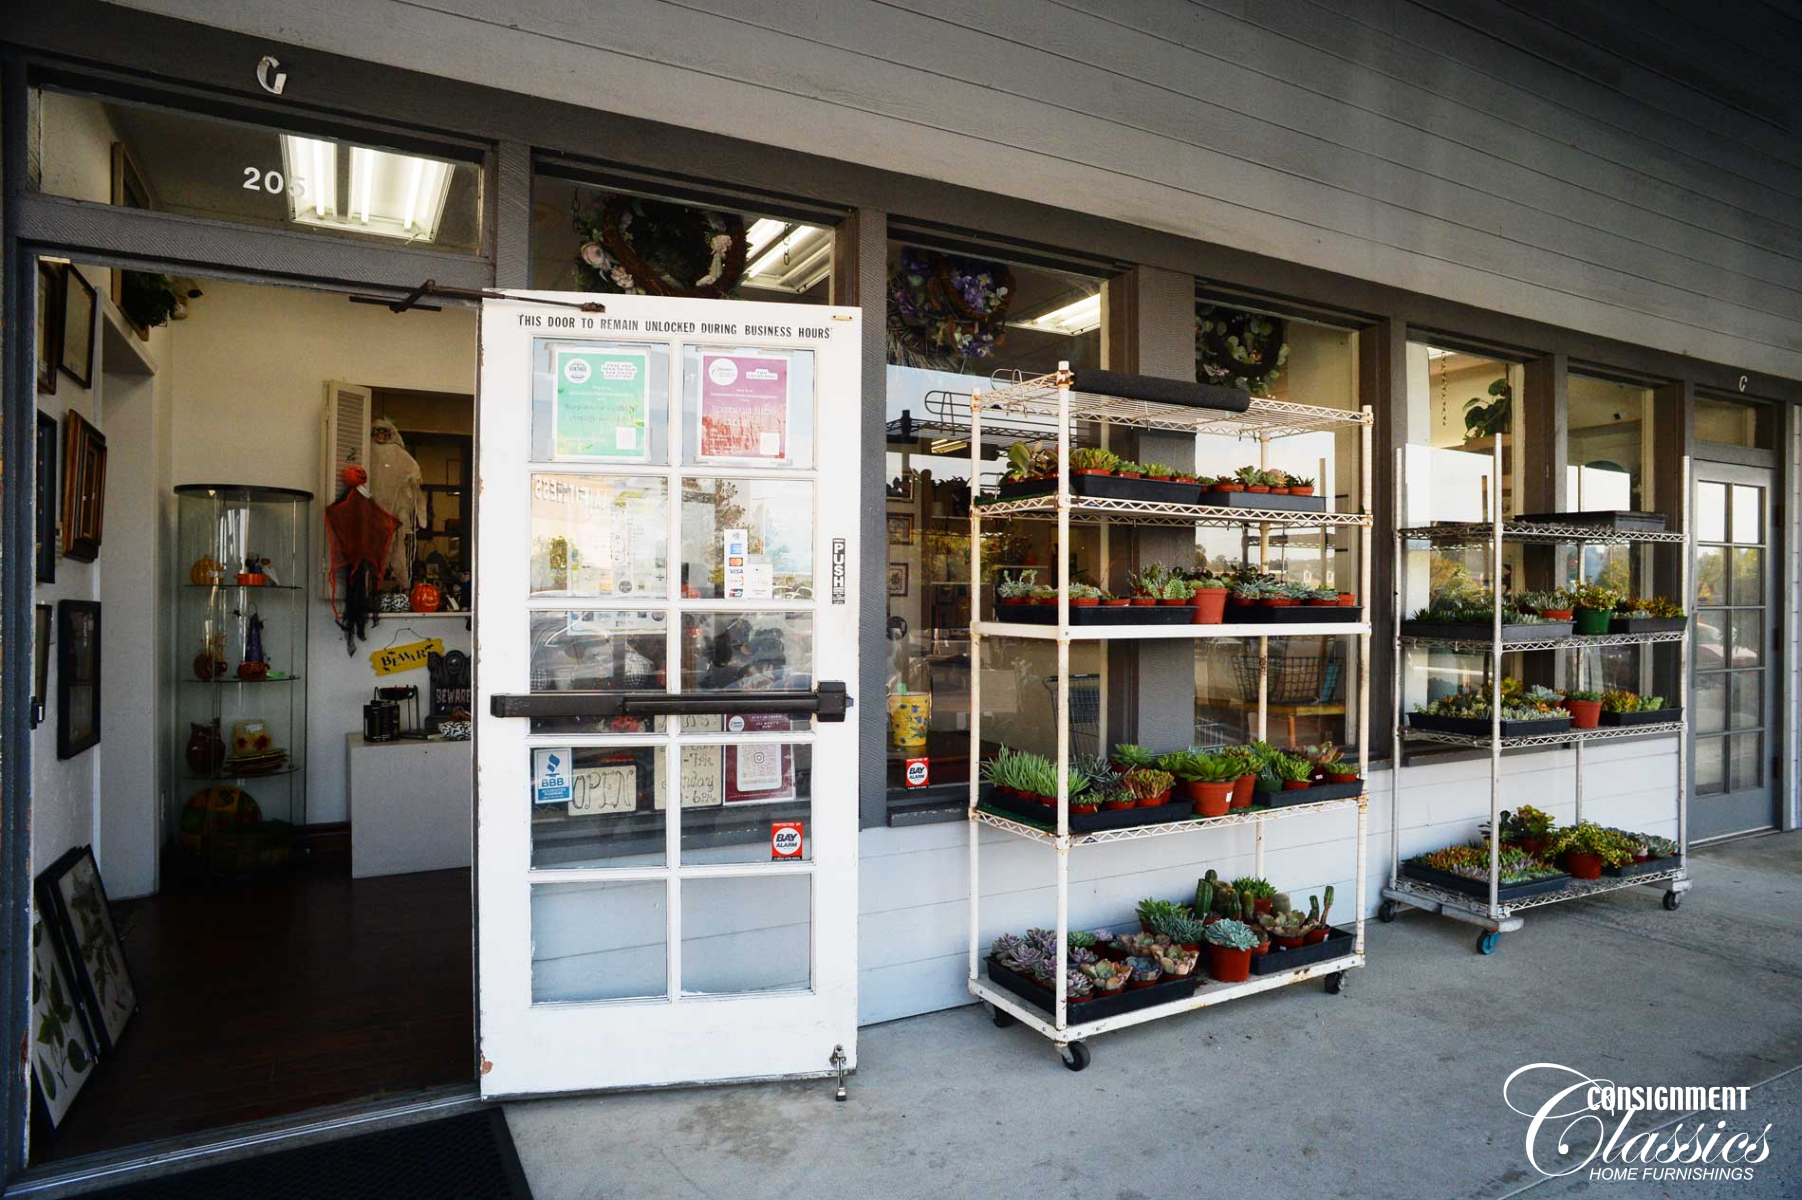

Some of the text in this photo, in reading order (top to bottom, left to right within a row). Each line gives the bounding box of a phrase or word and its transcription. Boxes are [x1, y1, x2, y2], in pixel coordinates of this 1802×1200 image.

[518, 314, 830, 339] THIS DOOR TO REMAIN UNLOCKED DURING BUSINESS HOURS
[833, 542, 844, 587] PUSH
[909, 766, 925, 775] BAY
[541, 777, 564, 788] BBB
[572, 770, 634, 810] OPEN
[776, 833, 798, 842] BAY
